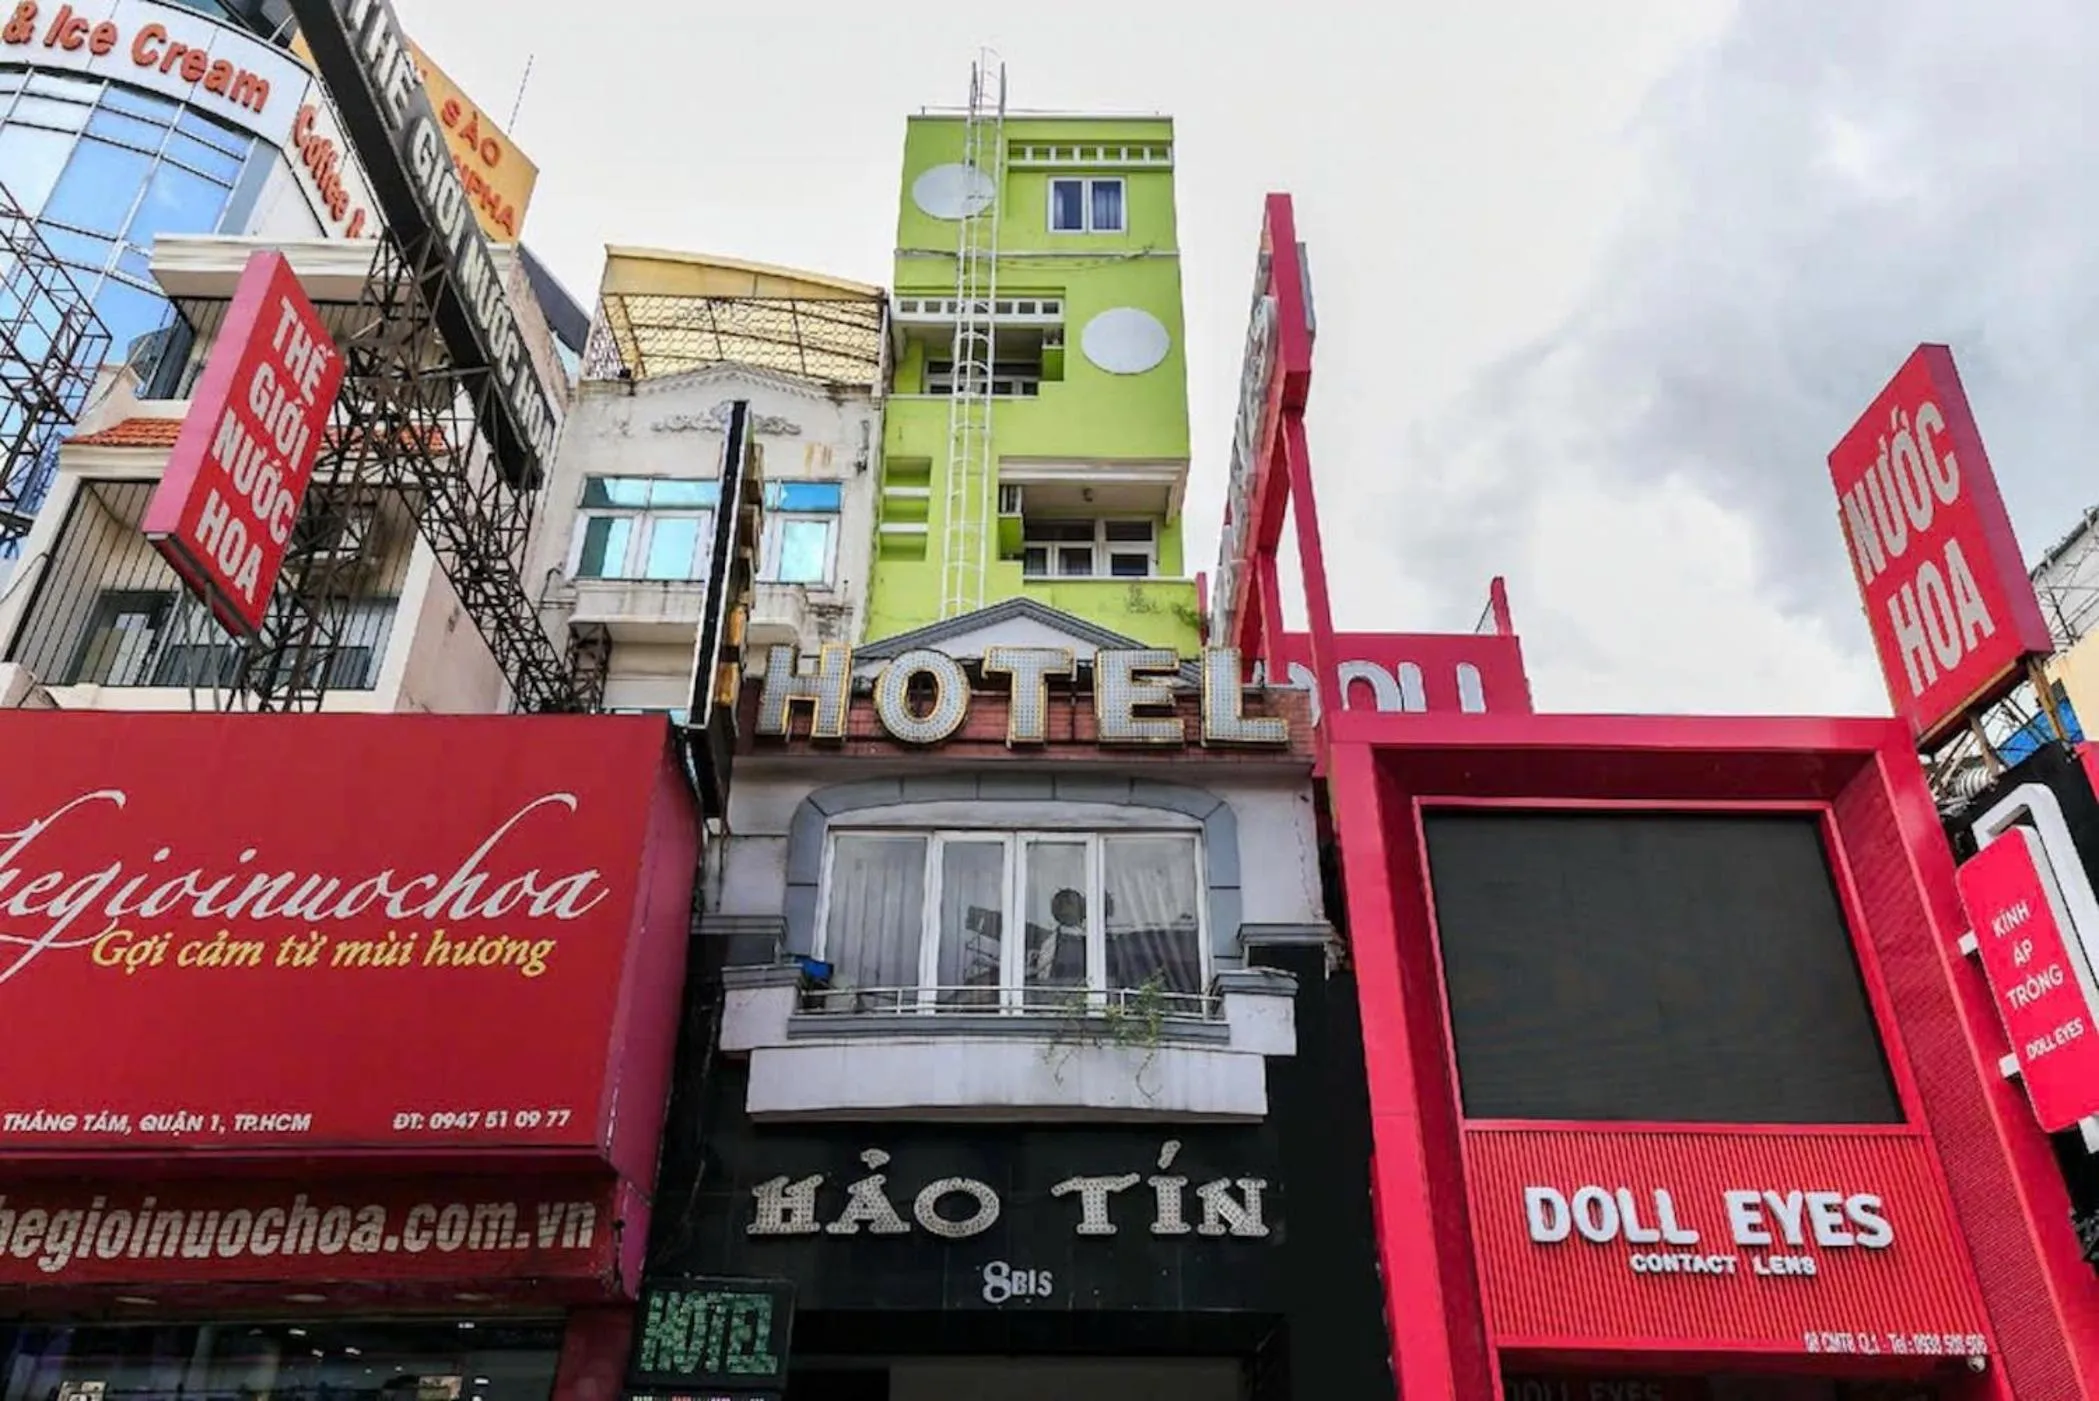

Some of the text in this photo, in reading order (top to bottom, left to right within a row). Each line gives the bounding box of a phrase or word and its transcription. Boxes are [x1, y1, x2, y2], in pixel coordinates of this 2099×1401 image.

[43, 4, 118, 56] Ice
[131, 23, 270, 114] Cream
[272, 296, 335, 407] THẾ
[249, 362, 310, 472] GIỚI
[211, 407, 296, 545] NƯỚC
[1842, 401, 1960, 587] NƯỚC
[195, 489, 284, 605] HOA
[1887, 537, 1995, 698] HOA
[755, 642, 1290, 750] HOTEL
[92, 929, 556, 977] Gợi cảm từ mùi hương
[2054, 1016, 2085, 1047] EYES
[3, 1109, 78, 1132] THÁNG
[82, 1110, 133, 1135] TÁM,
[139, 1110, 204, 1136] QUẬN
[209, 1113, 226, 1134] 1,
[429, 1111, 481, 1130] 0947
[484, 1110, 509, 1129] 51
[514, 1110, 542, 1128] 09
[546, 1109, 572, 1127] 77
[746, 1139, 1271, 1238] HẢO TÍN
[1523, 1186, 1895, 1250] DOLL EYES
[1630, 1252, 1818, 1279] CONTACT LENS
